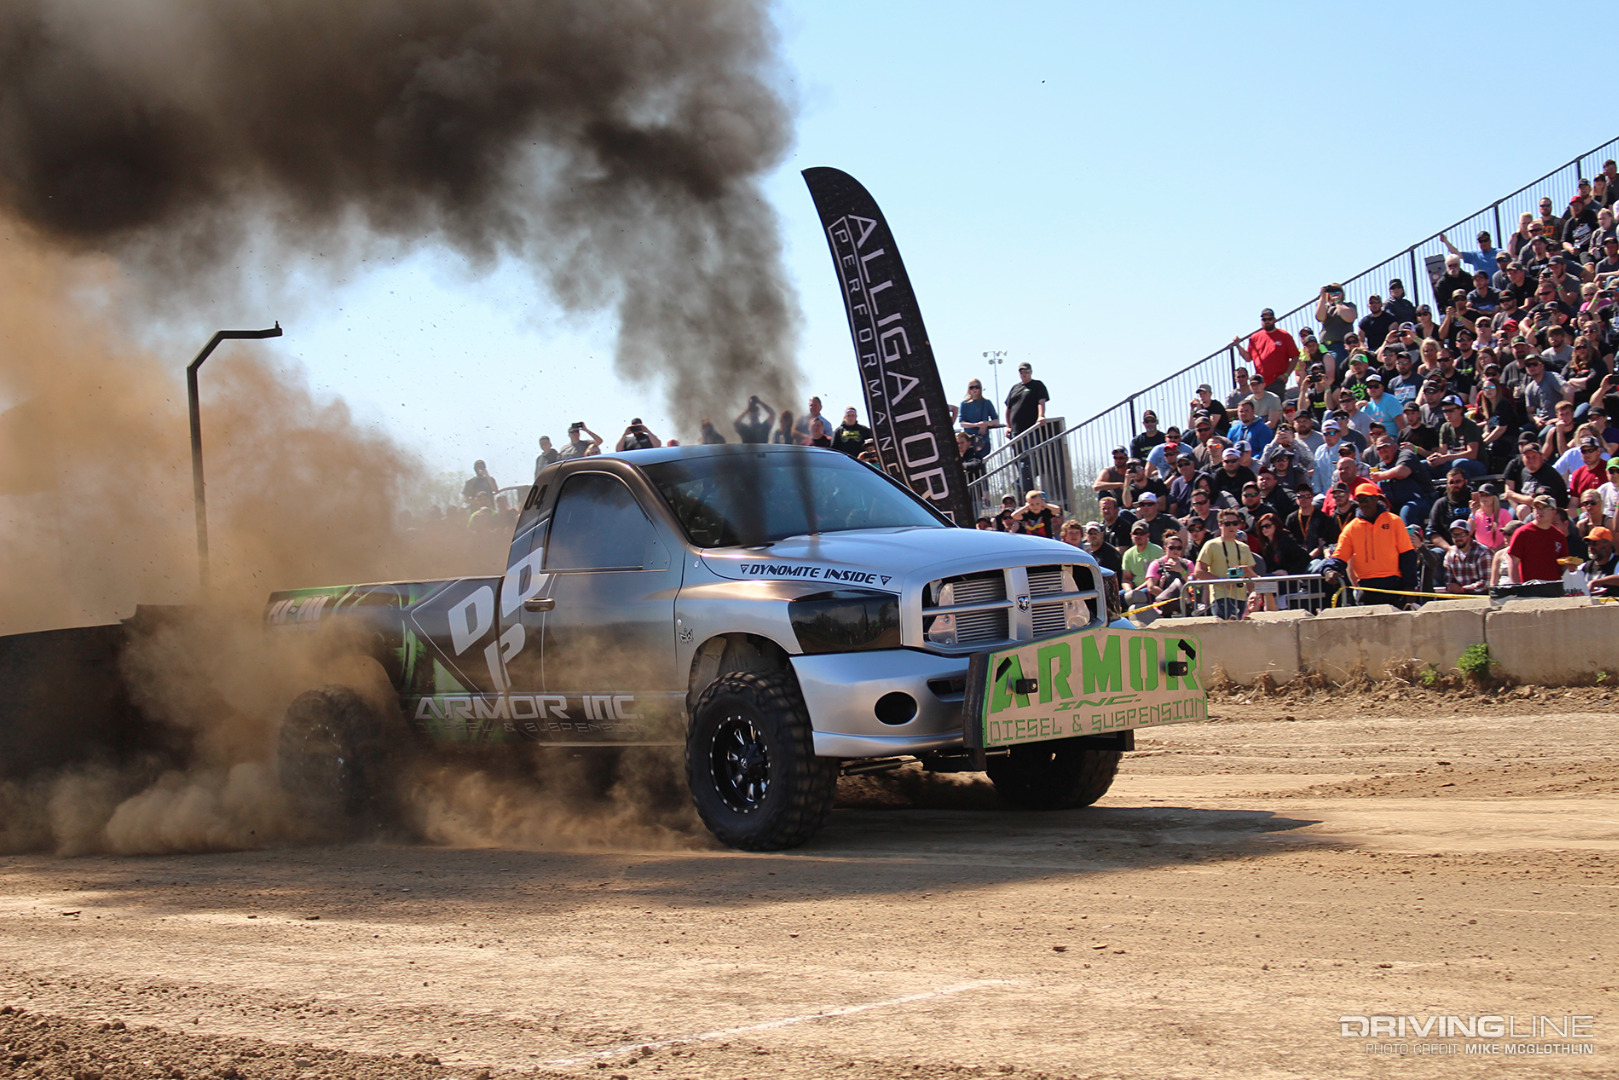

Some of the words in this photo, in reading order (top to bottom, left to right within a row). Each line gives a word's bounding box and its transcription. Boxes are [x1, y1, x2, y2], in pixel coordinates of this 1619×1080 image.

[833, 227, 900, 475] PERFORMANC
[847, 213, 950, 501] ALLIGATOR
[524, 484, 549, 511] 04
[749, 564, 822, 578] DYNOMITE
[824, 568, 877, 584] INSIDE
[990, 634, 1199, 714] ARMOR
[415, 694, 571, 720] ARMOR
[1053, 693, 1142, 712] INC.
[504, 721, 517, 732] &
[990, 717, 1062, 742] DIESEL
[1072, 714, 1083, 733] &
[1091, 695, 1207, 730] SUSPENSION
